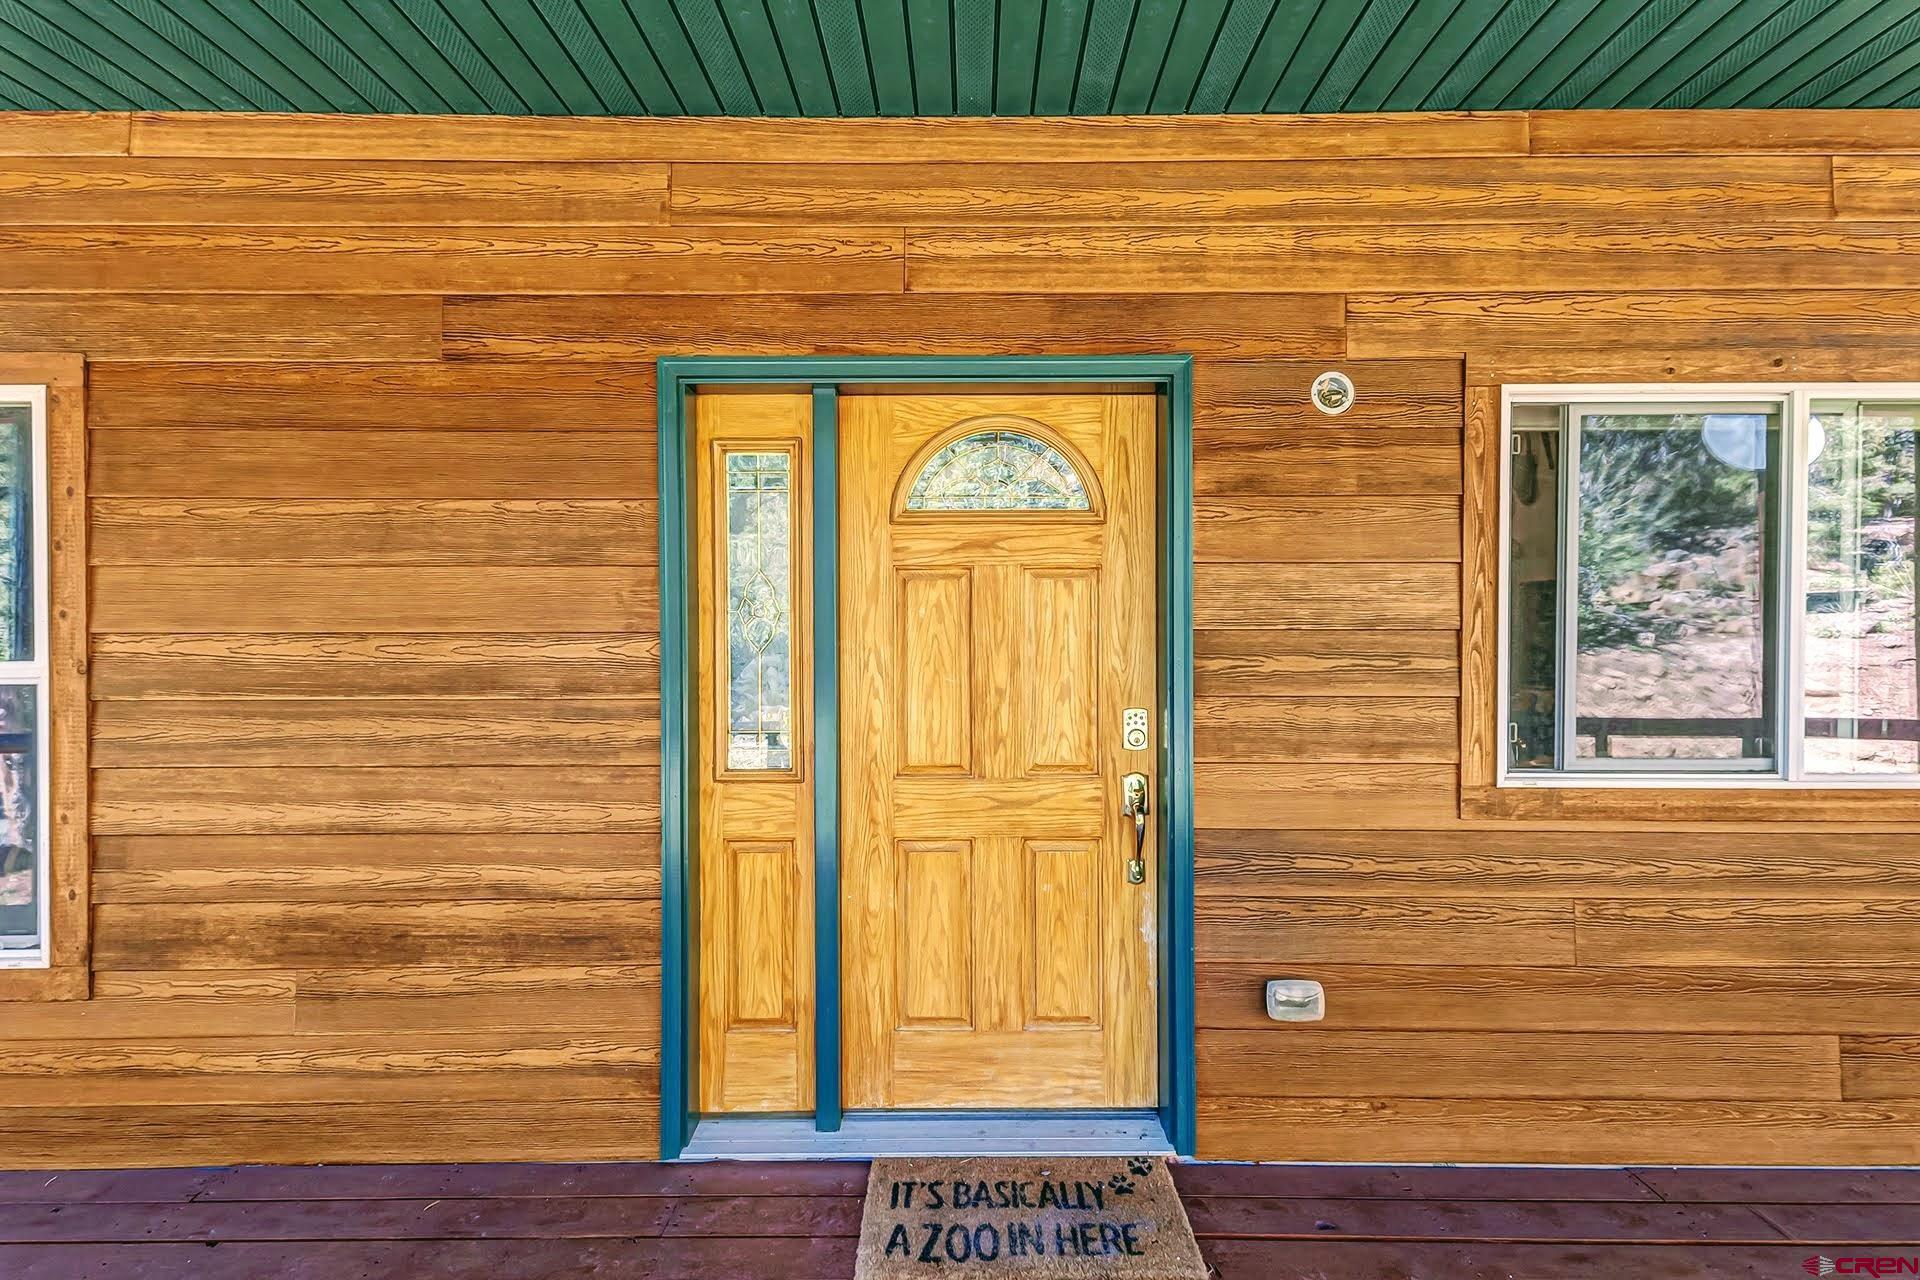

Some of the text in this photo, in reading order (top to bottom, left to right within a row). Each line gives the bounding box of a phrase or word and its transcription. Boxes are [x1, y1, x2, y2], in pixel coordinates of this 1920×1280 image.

[890, 1179, 1105, 1211] IT'S BASICALLY
[885, 1221, 1146, 1264] A ZOO IN HERE
